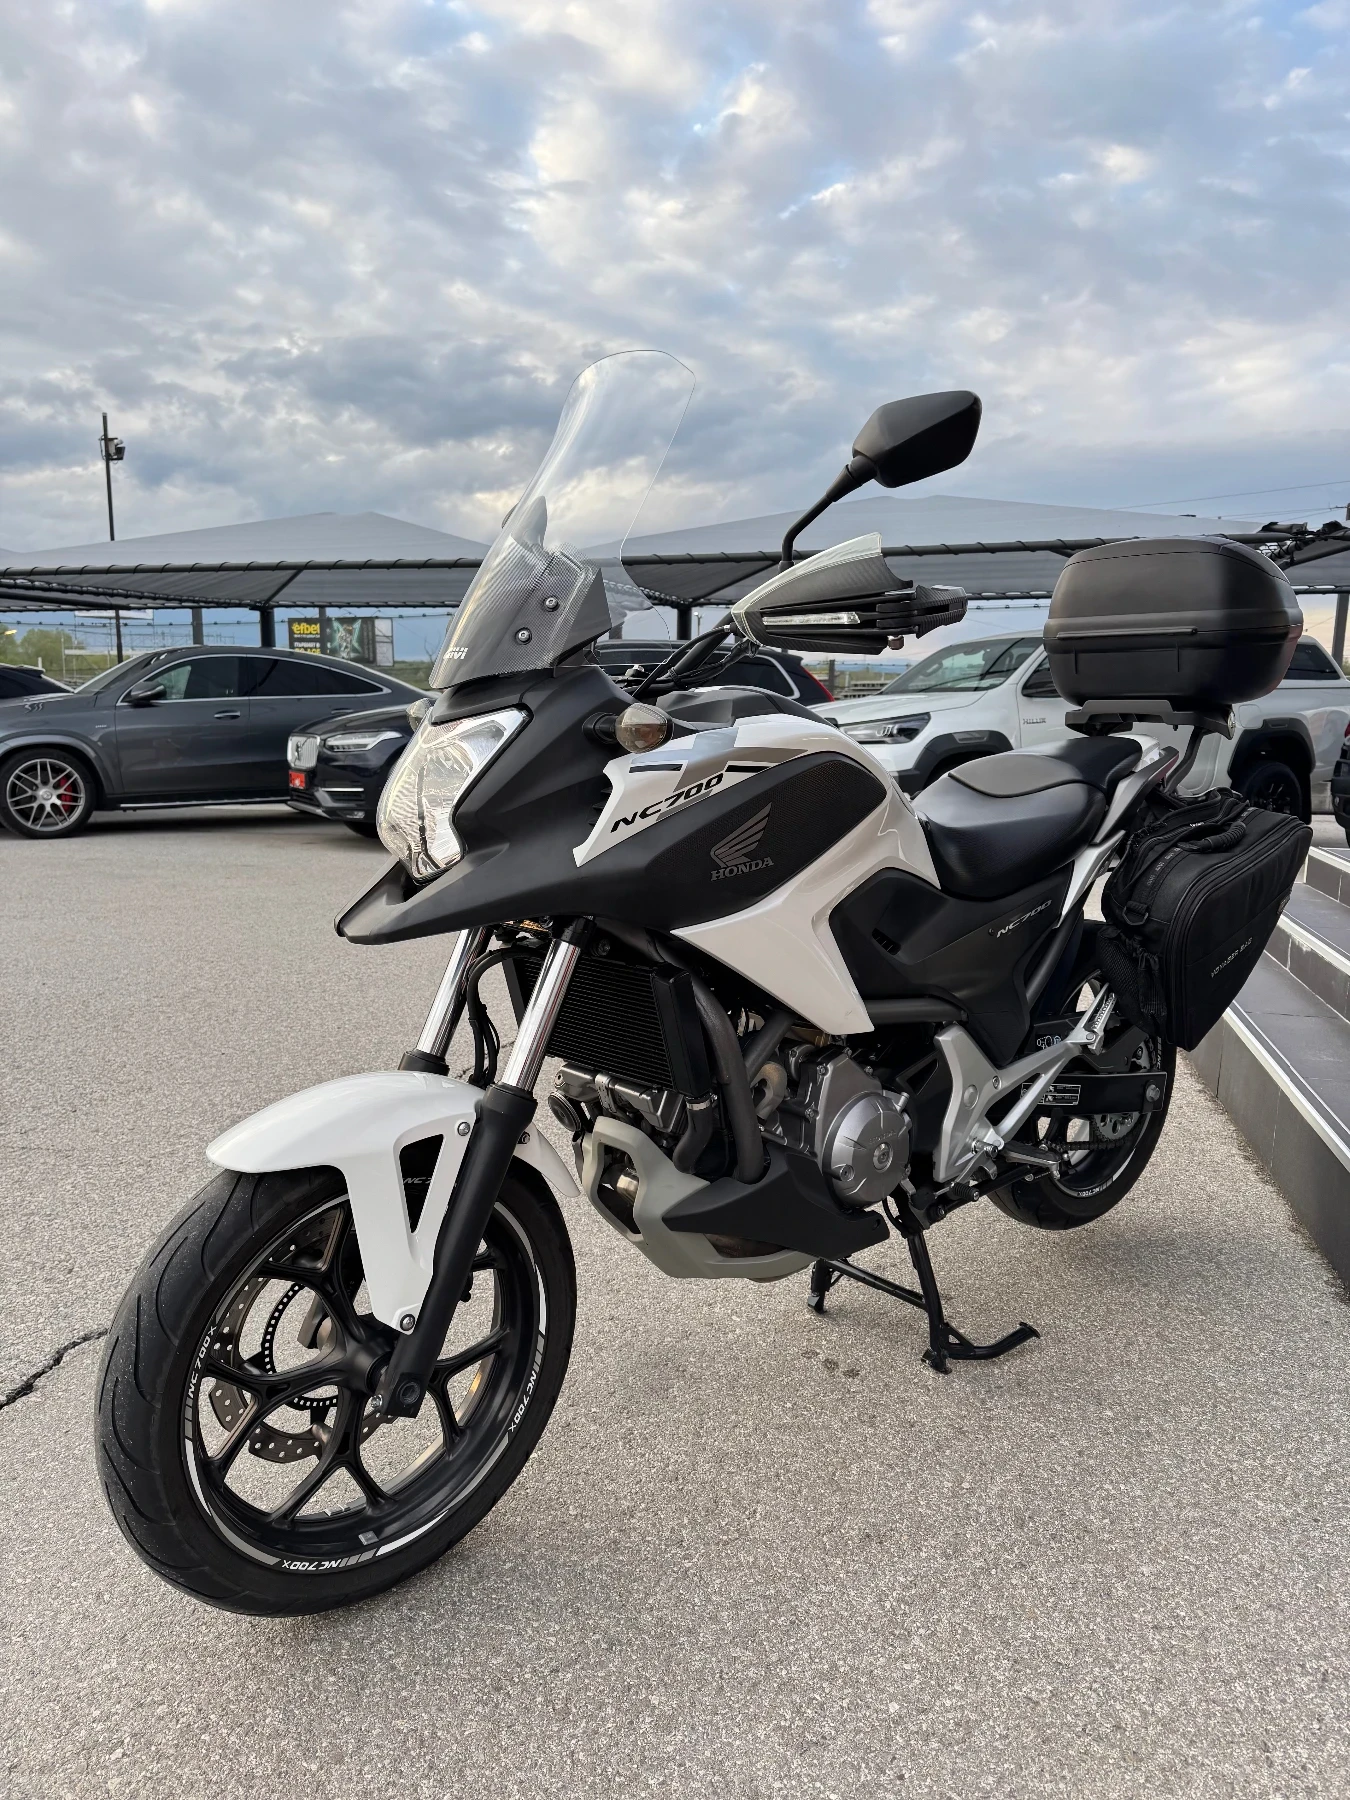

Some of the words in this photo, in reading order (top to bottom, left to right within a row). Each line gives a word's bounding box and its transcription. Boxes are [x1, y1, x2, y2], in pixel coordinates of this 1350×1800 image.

[610, 773, 724, 833] NC700
[710, 856, 774, 882] HONDA
[996, 899, 1052, 938] NC700
[187, 1325, 218, 1399] NC700X
[507, 1370, 538, 1433] NC700X
[281, 1558, 342, 1571] NC700X
